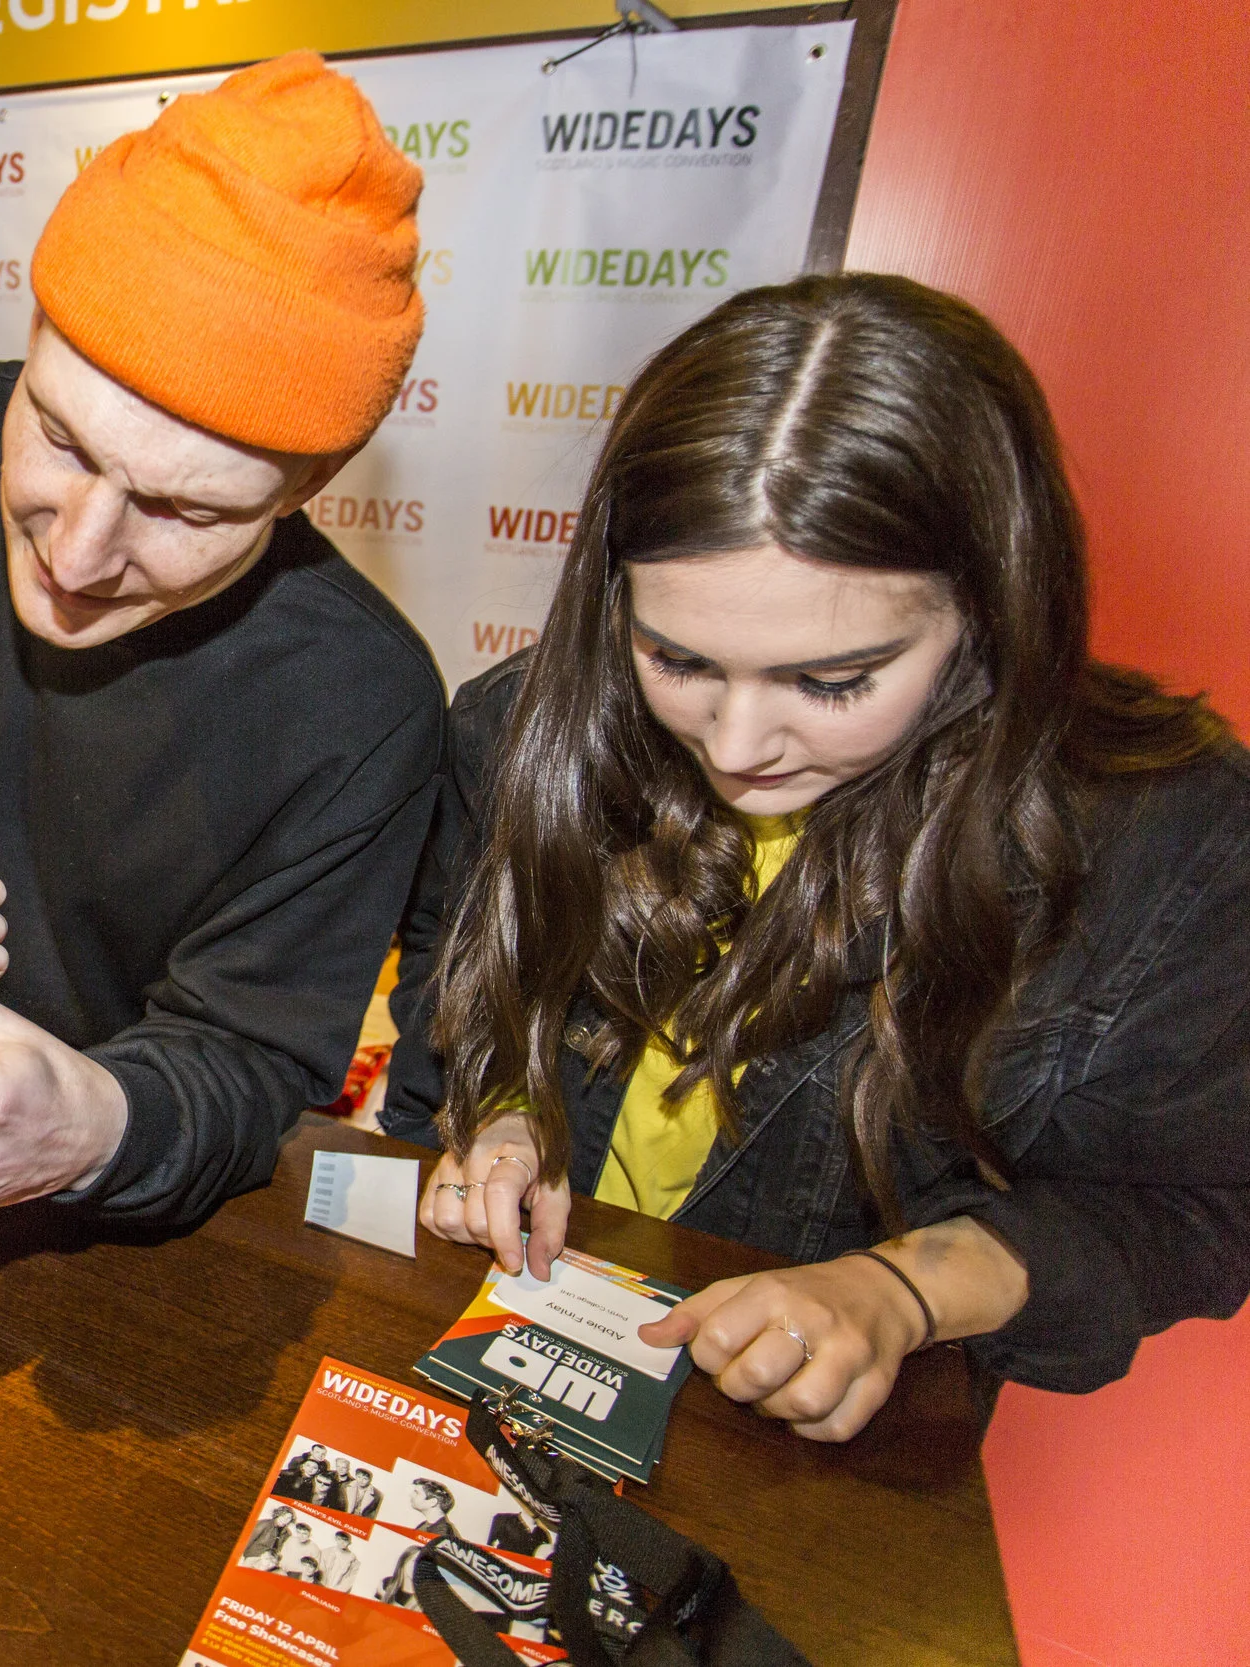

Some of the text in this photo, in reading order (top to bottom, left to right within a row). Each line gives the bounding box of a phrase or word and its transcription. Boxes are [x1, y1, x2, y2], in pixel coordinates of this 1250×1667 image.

[543, 105, 761, 153] WIDEDAYS
[526, 248, 730, 288] WIDEDAYS
[309, 495, 424, 532] EDAYS
[546, 1302, 626, 1341] Abbie Finlay
[576, 1296, 605, 1311] College
[502, 1323, 623, 1390] WIDEDAYS
[508, 1318, 629, 1378] SCOTLAND'S MUSIC CONVENTION
[316, 1387, 458, 1447] SCOTLAND'S MUSIC CONVENTION
[324, 1369, 463, 1438] WIDEDAYS
[389, 1386, 417, 1401] EDITION
[293, 1501, 368, 1537] FRANKY'S EVIL PARTY
[436, 1538, 551, 1603] AWESOME
[213, 1609, 332, 1667] Free Showcases
[219, 1596, 340, 1660] FRIDAY 12 APRIL
